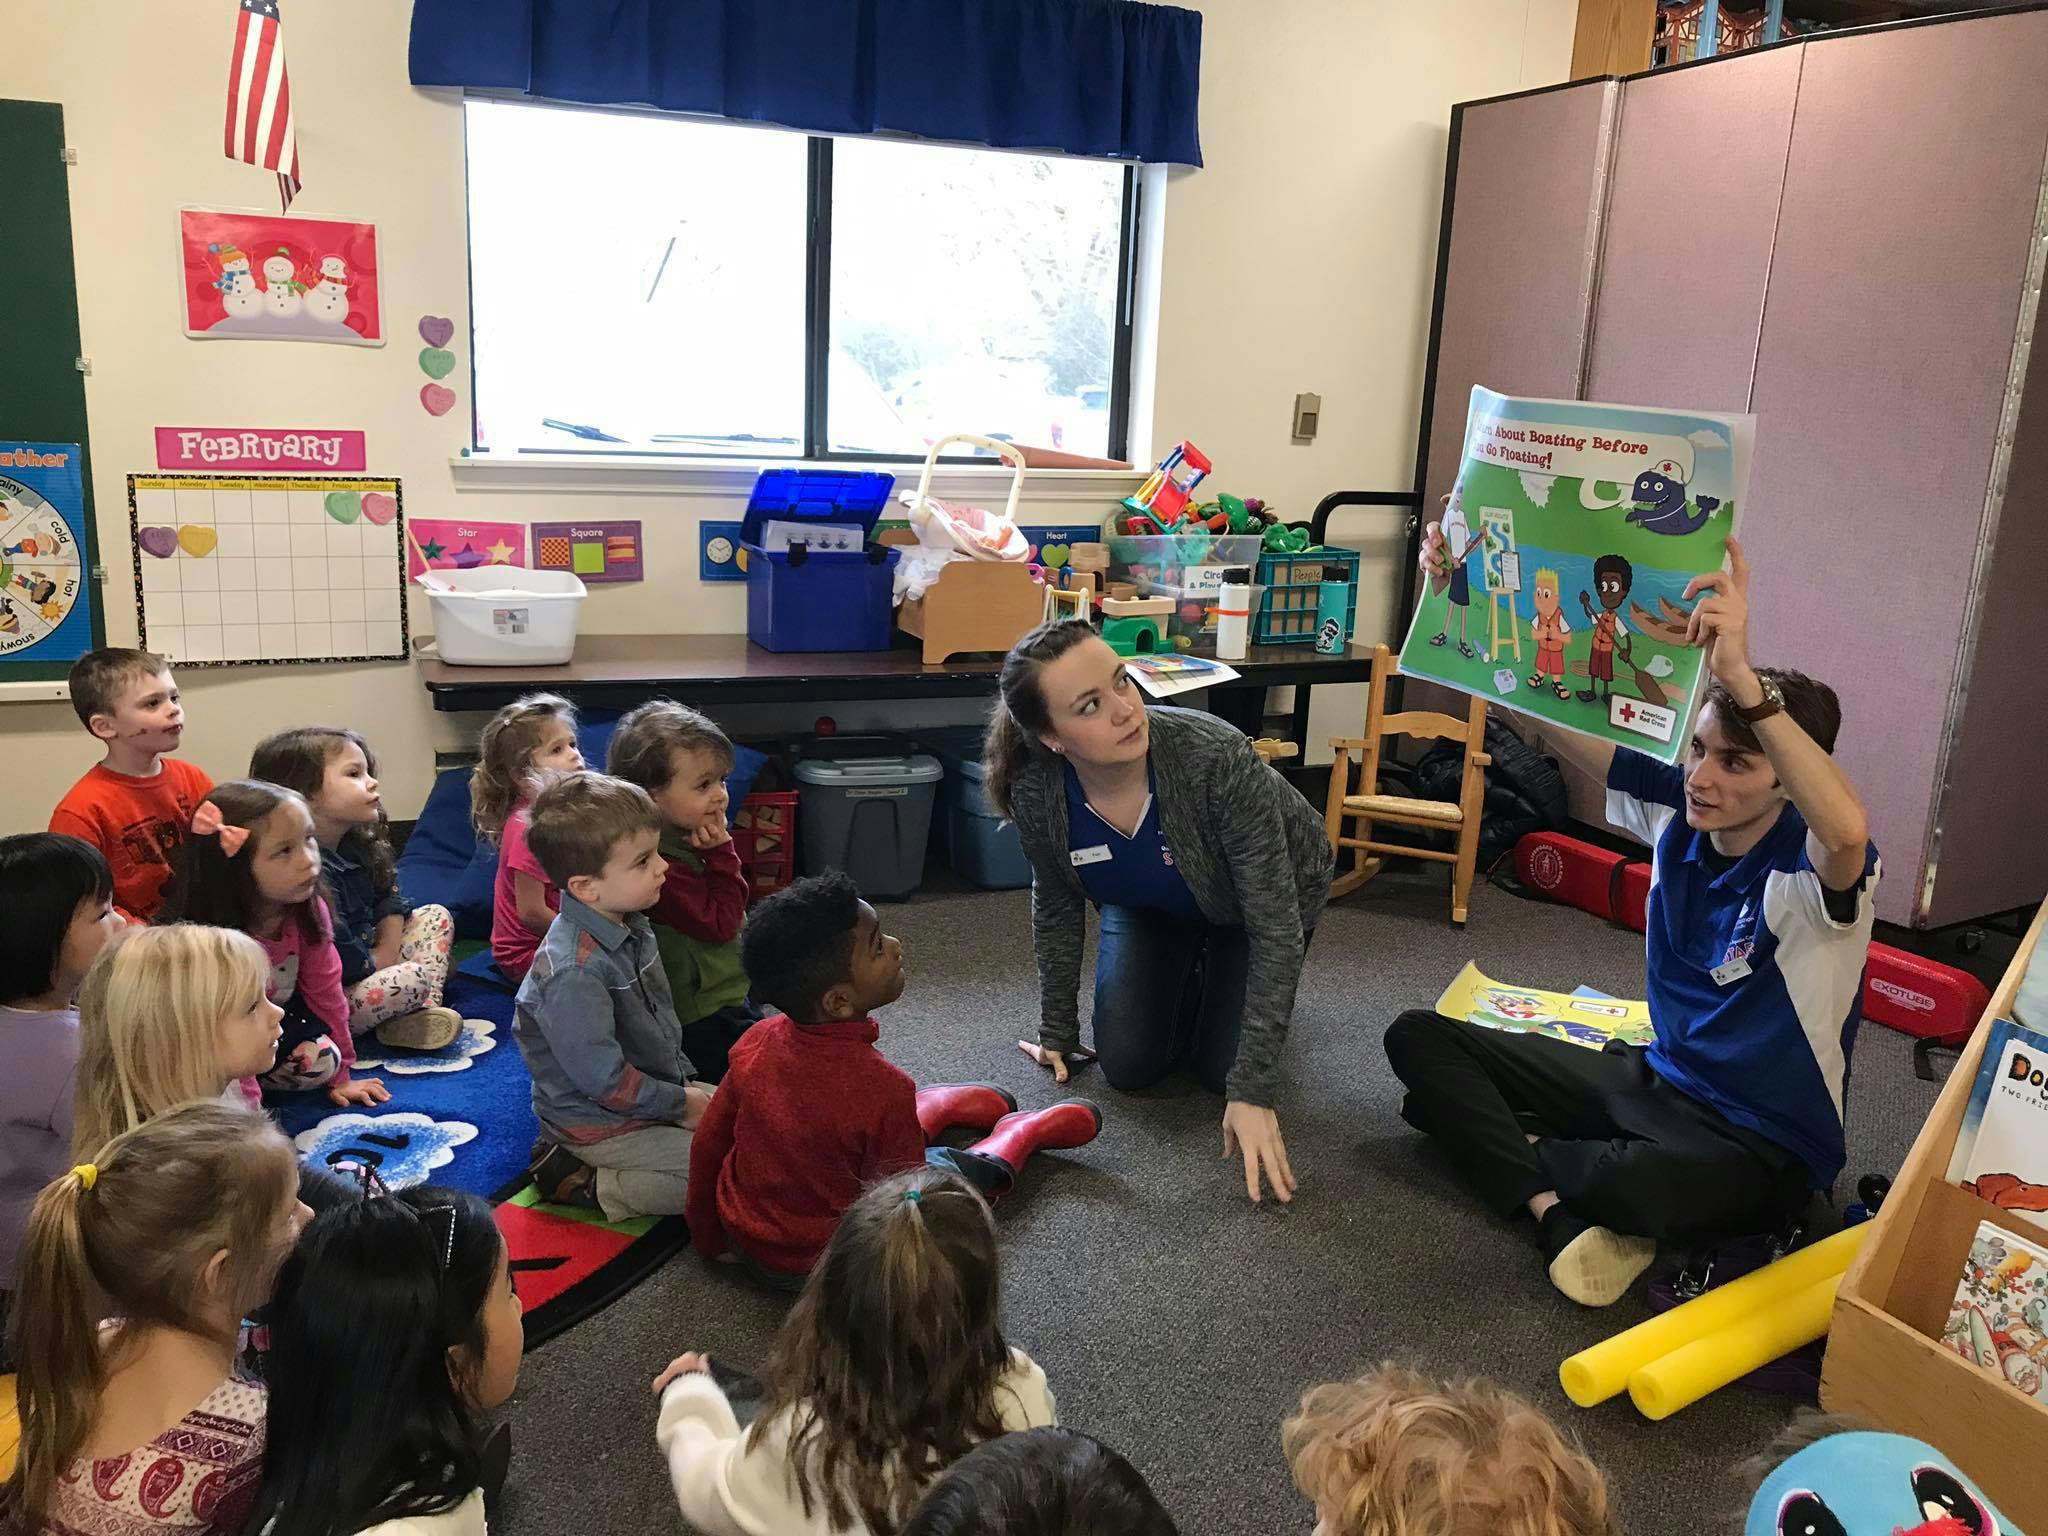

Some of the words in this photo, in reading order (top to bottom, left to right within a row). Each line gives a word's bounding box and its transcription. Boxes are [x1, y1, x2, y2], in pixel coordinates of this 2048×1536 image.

[1495, 424, 1525, 442] About
[1529, 430, 1586, 451] Boating
[1592, 436, 1648, 455] Before
[1486, 443, 1497, 456] Go
[1500, 446, 1552, 469] Floating!
[141, 479, 165, 488] Sunday
[180, 479, 207, 488] Monday
[219, 480, 245, 489] Tuesday
[51, 521, 70, 544] cold
[458, 527, 478, 537] Star
[571, 528, 604, 540] Square
[1046, 531, 1067, 540] Heart
[64, 579, 78, 597] hot
[0, 633, 35, 651] snowy
[1639, 715, 1650, 724] Red
[1651, 718, 1666, 729] Cross
[1641, 709, 1667, 722] American
[1873, 980, 1933, 1008] EXOTUBE
[2001, 1085, 2022, 1099] TWO
[1983, 1350, 1996, 1367] S
